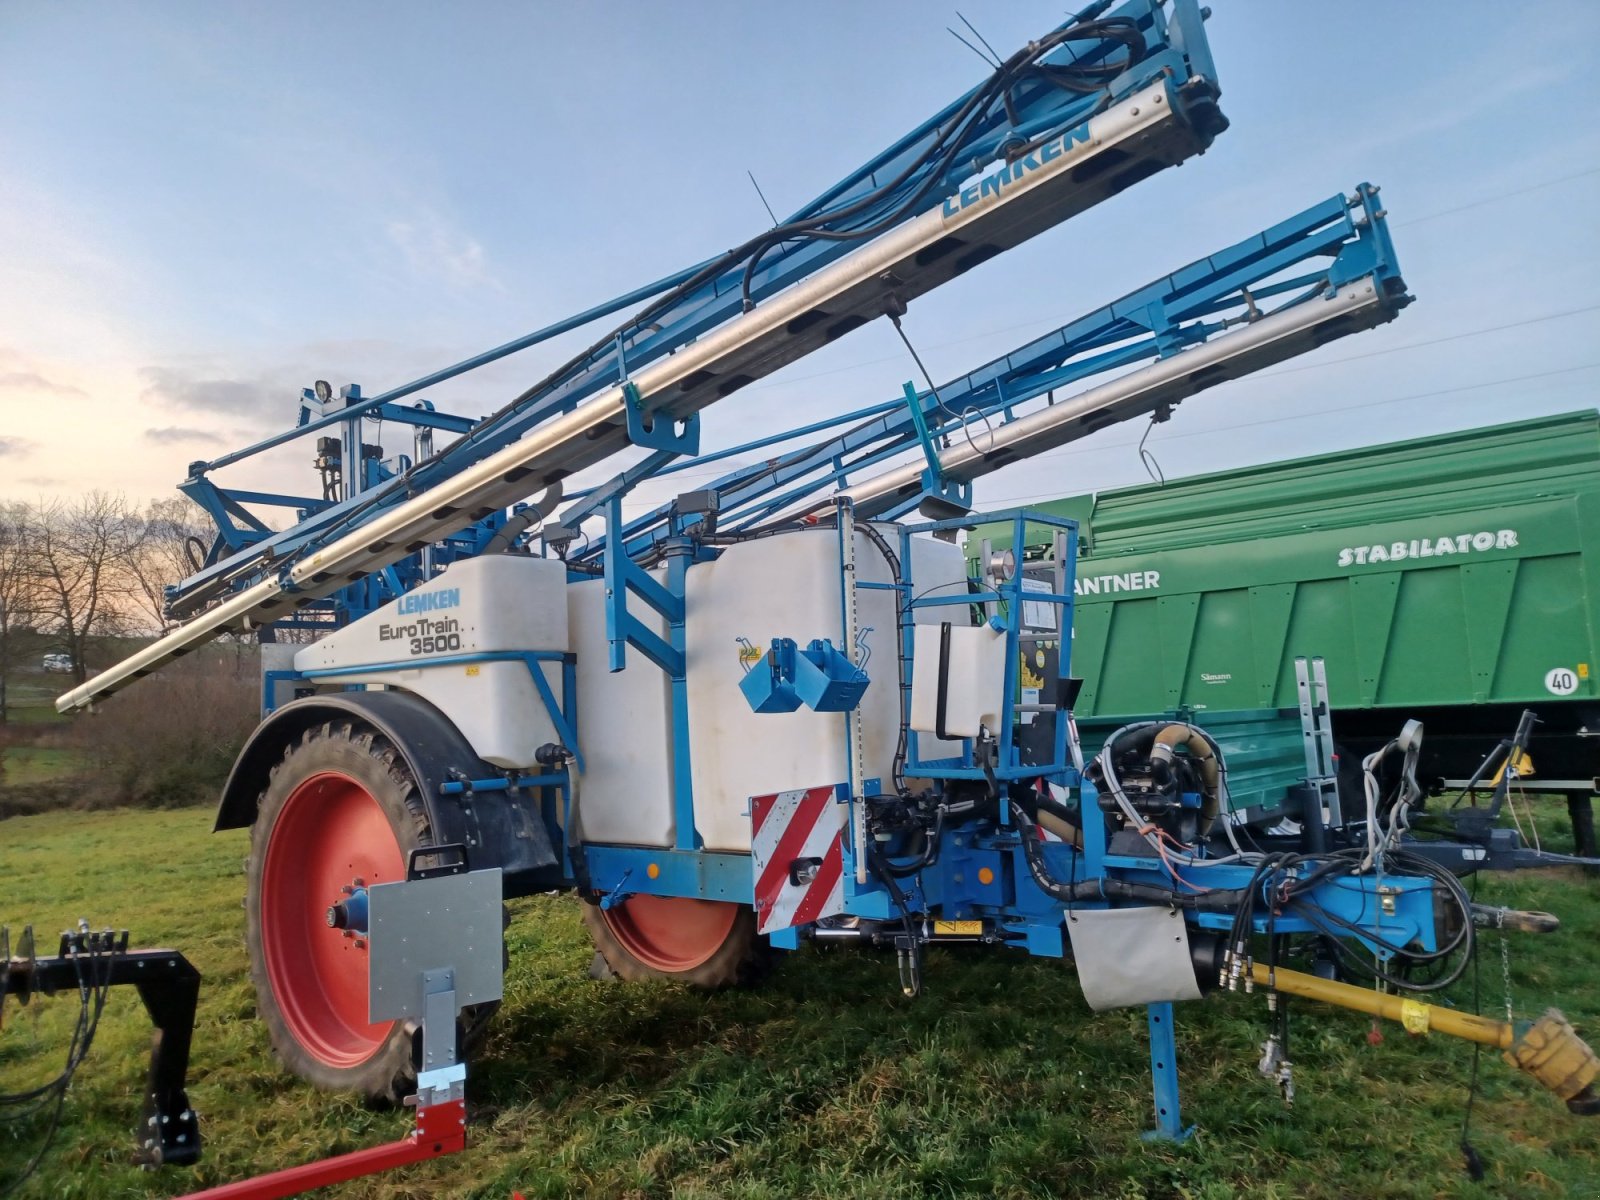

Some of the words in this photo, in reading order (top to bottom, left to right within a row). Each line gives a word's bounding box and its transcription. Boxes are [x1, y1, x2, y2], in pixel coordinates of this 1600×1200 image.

[943, 120, 1091, 219] LEMKEN
[1338, 529, 1519, 567] STABILATOR
[1073, 570, 1160, 596] ANTNER
[398, 588, 460, 615] LEMKEN
[410, 633, 460, 655] 3500
[1552, 673, 1572, 690] 40
